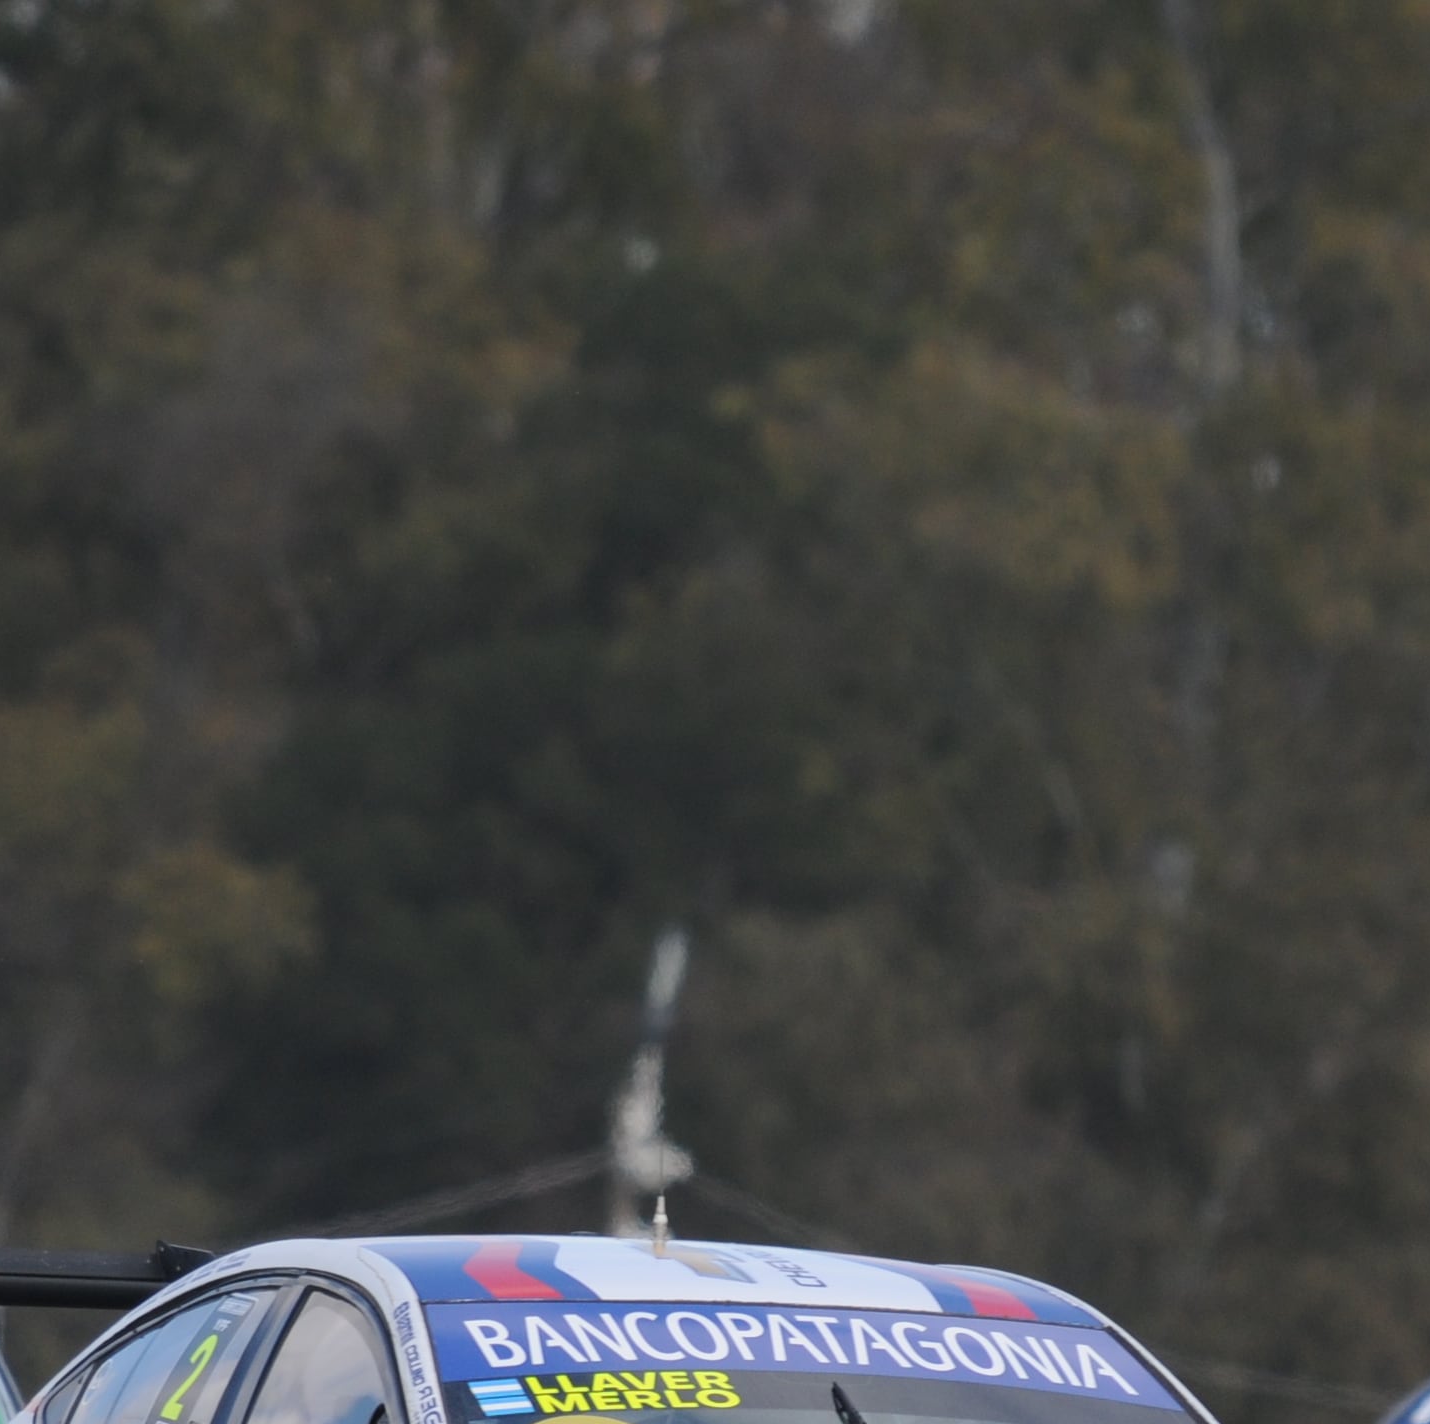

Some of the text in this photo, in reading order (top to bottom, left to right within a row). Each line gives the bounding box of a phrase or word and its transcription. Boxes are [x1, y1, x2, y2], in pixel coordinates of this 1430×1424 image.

[160, 1334, 219, 1421] 2
[463, 1311, 1139, 1396] BANCOPATAGONIA
[525, 1370, 734, 1395] LLAVER
[535, 1388, 742, 1414] MERLO
